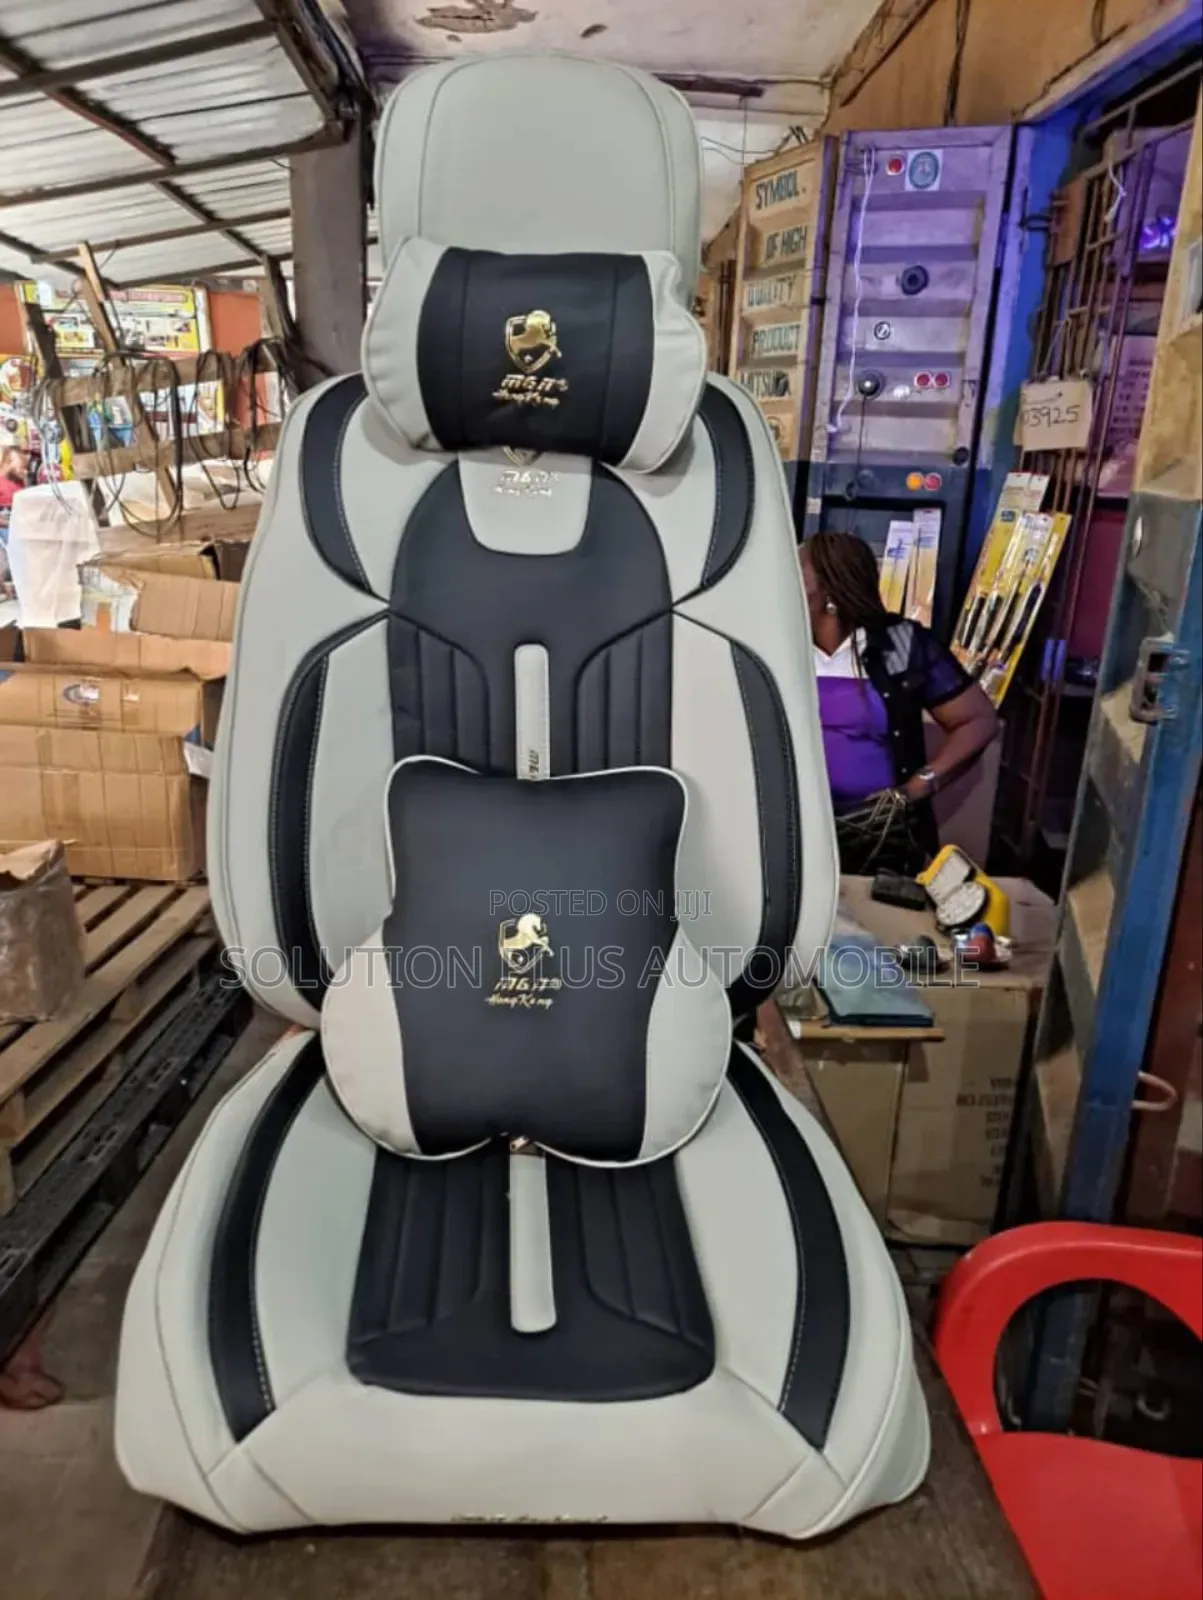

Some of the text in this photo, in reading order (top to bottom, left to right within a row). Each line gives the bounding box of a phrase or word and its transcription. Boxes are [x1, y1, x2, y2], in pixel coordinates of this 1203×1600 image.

[765, 226, 807, 260] OF HIGH
[753, 324, 800, 355] PRODUCT
